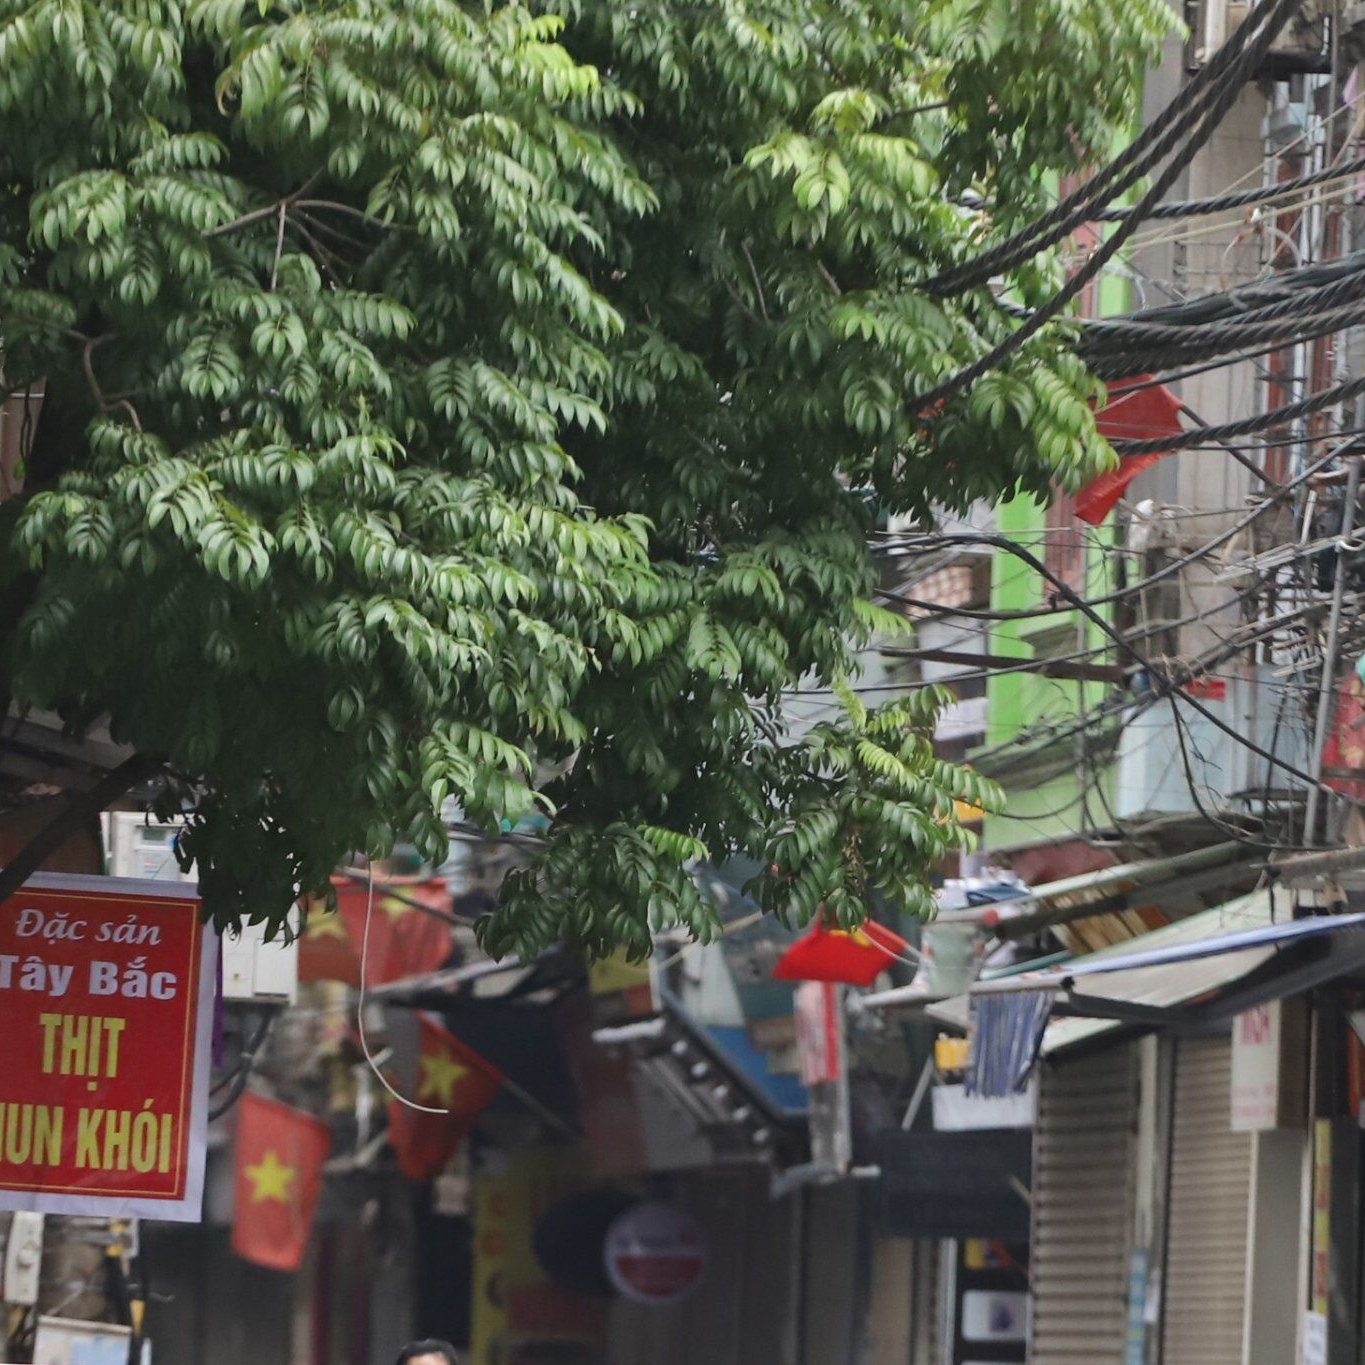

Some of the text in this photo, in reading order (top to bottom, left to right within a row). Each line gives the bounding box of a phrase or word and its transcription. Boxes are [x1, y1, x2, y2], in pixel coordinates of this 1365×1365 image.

[15, 908, 162, 946] Đặc sản
[88, 956, 178, 1000] Bắc
[39, 1012, 125, 1091] THỊT
[75, 1098, 173, 1174] KHÓI
